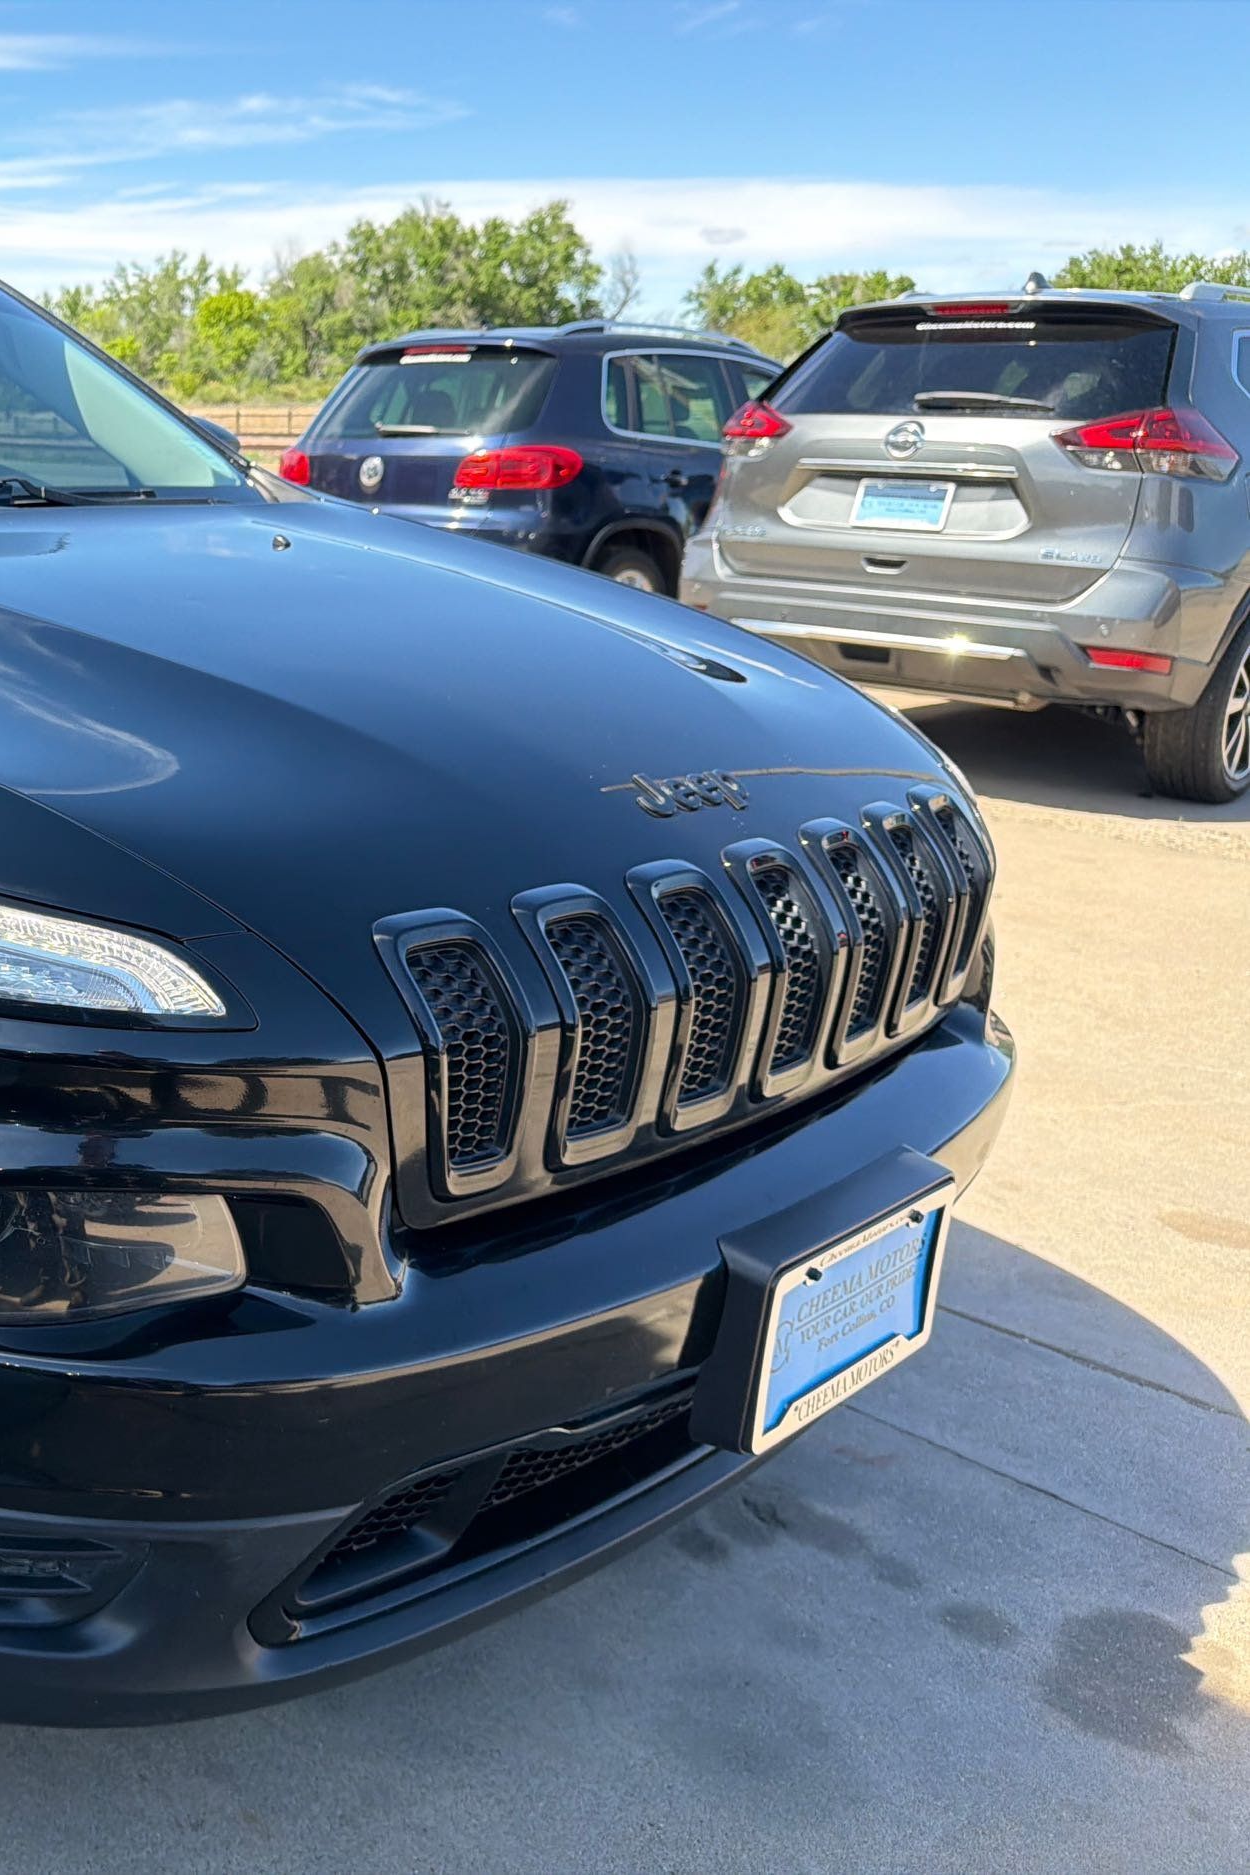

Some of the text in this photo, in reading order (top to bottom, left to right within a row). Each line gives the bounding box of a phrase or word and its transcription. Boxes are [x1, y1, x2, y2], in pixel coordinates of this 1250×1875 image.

[631, 769, 750, 818] Jeep
[797, 1271, 862, 1323] CHEEMA
[800, 1314, 831, 1344] YOUR
[860, 1283, 883, 1308] OUR
[818, 1331, 839, 1352] Fort
[879, 1294, 896, 1313] CO
